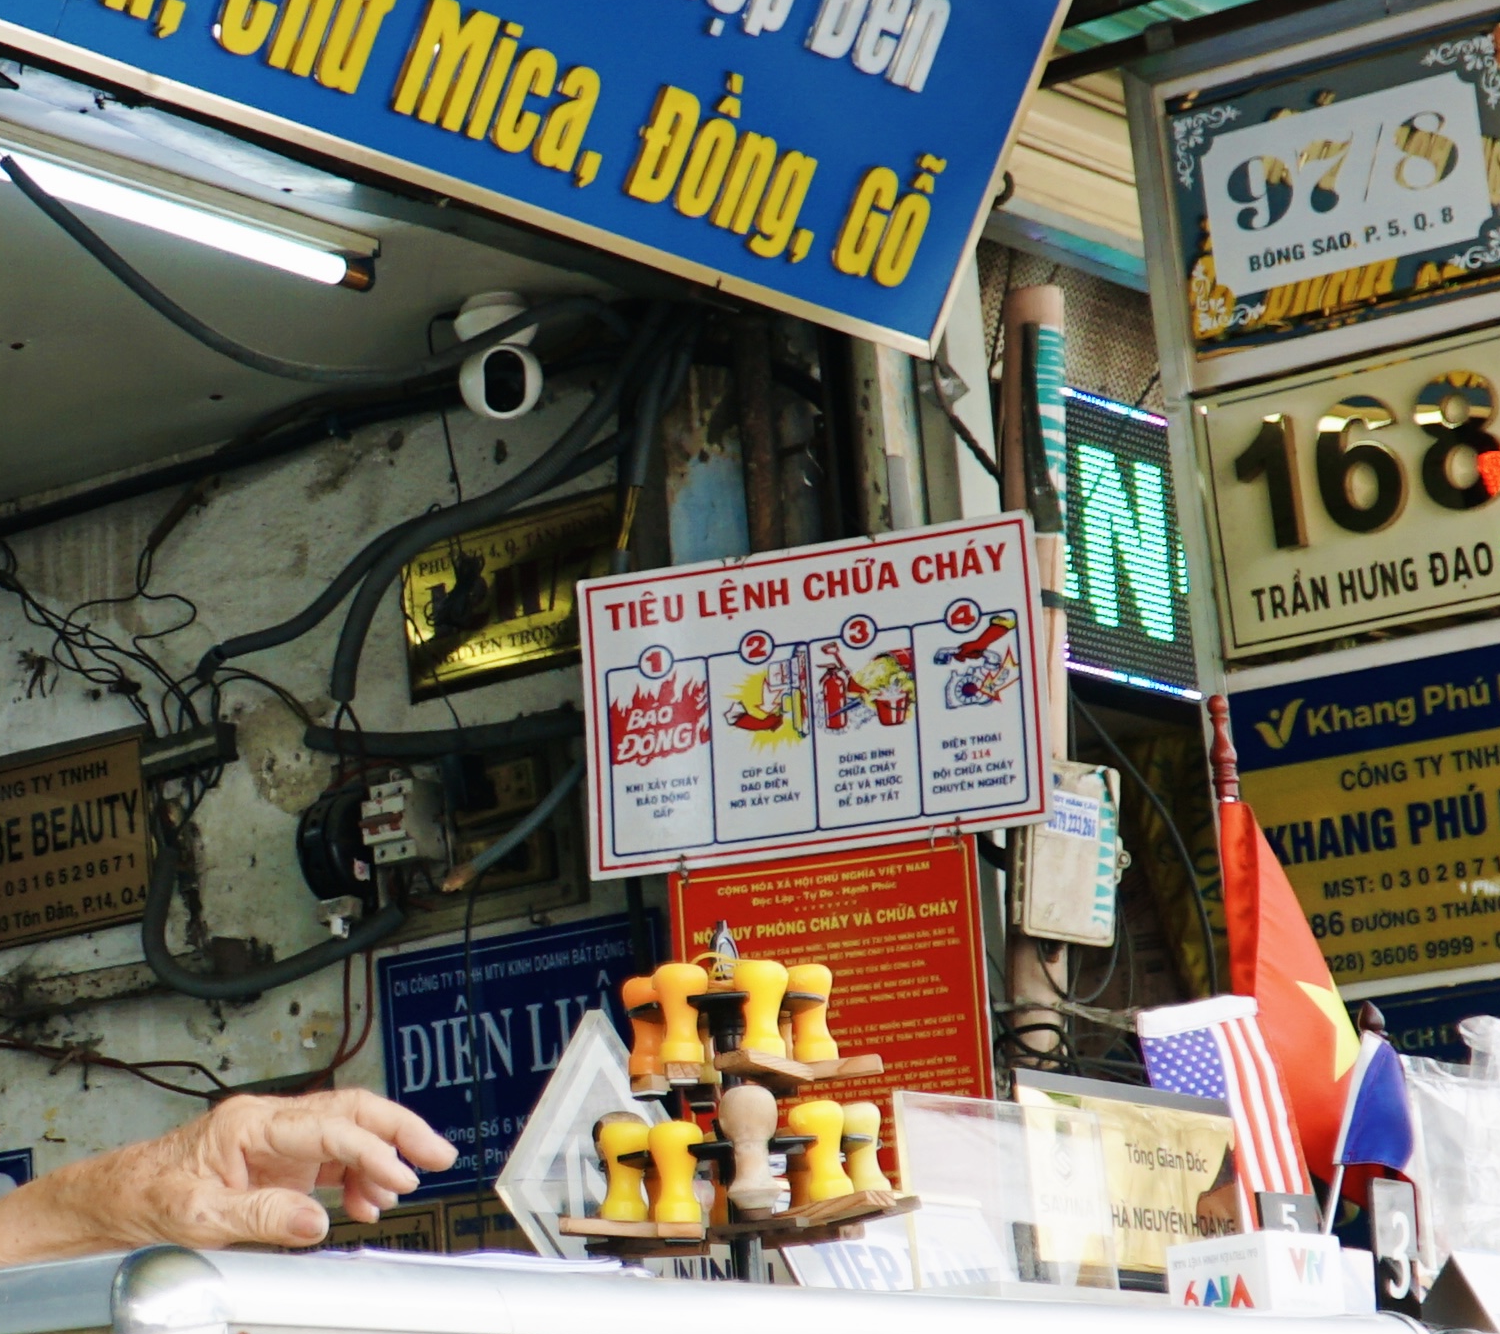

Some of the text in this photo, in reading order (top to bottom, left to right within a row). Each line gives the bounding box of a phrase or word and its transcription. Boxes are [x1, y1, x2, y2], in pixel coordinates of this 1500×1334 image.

[622, 71, 817, 268] Đồng,
[829, 151, 950, 292] Gỗ
[1225, 110, 1461, 233] 97/8
[1247, 205, 1455, 274] BÔNG SAO, P. 5, Q. 8
[604, 538, 1007, 632] TIÊU LỆNH CHỮA CHÁY
[1251, 568, 1331, 624] TRẦN
[1338, 557, 1419, 605] HƯNG
[1427, 541, 1496, 590] ĐẠO
[626, 703, 674, 732] BÁO
[1307, 694, 1416, 737] Khang
[1423, 678, 1493, 717] Phú
[616, 722, 692, 764] ĐỘNG
[30, 788, 139, 858] BEAUTY
[1263, 807, 1396, 867] KHANG
[1409, 784, 1487, 846] PHÚ
[756, 897, 959, 939] PHÒNG CHÁY VÀ CHỮA CHÁY
[1371, 943, 1418, 968] 3606
[1426, 936, 1474, 961] 9999
[1156, 1146, 1185, 1168] Giám
[1186, 1148, 1209, 1174] Đốc
